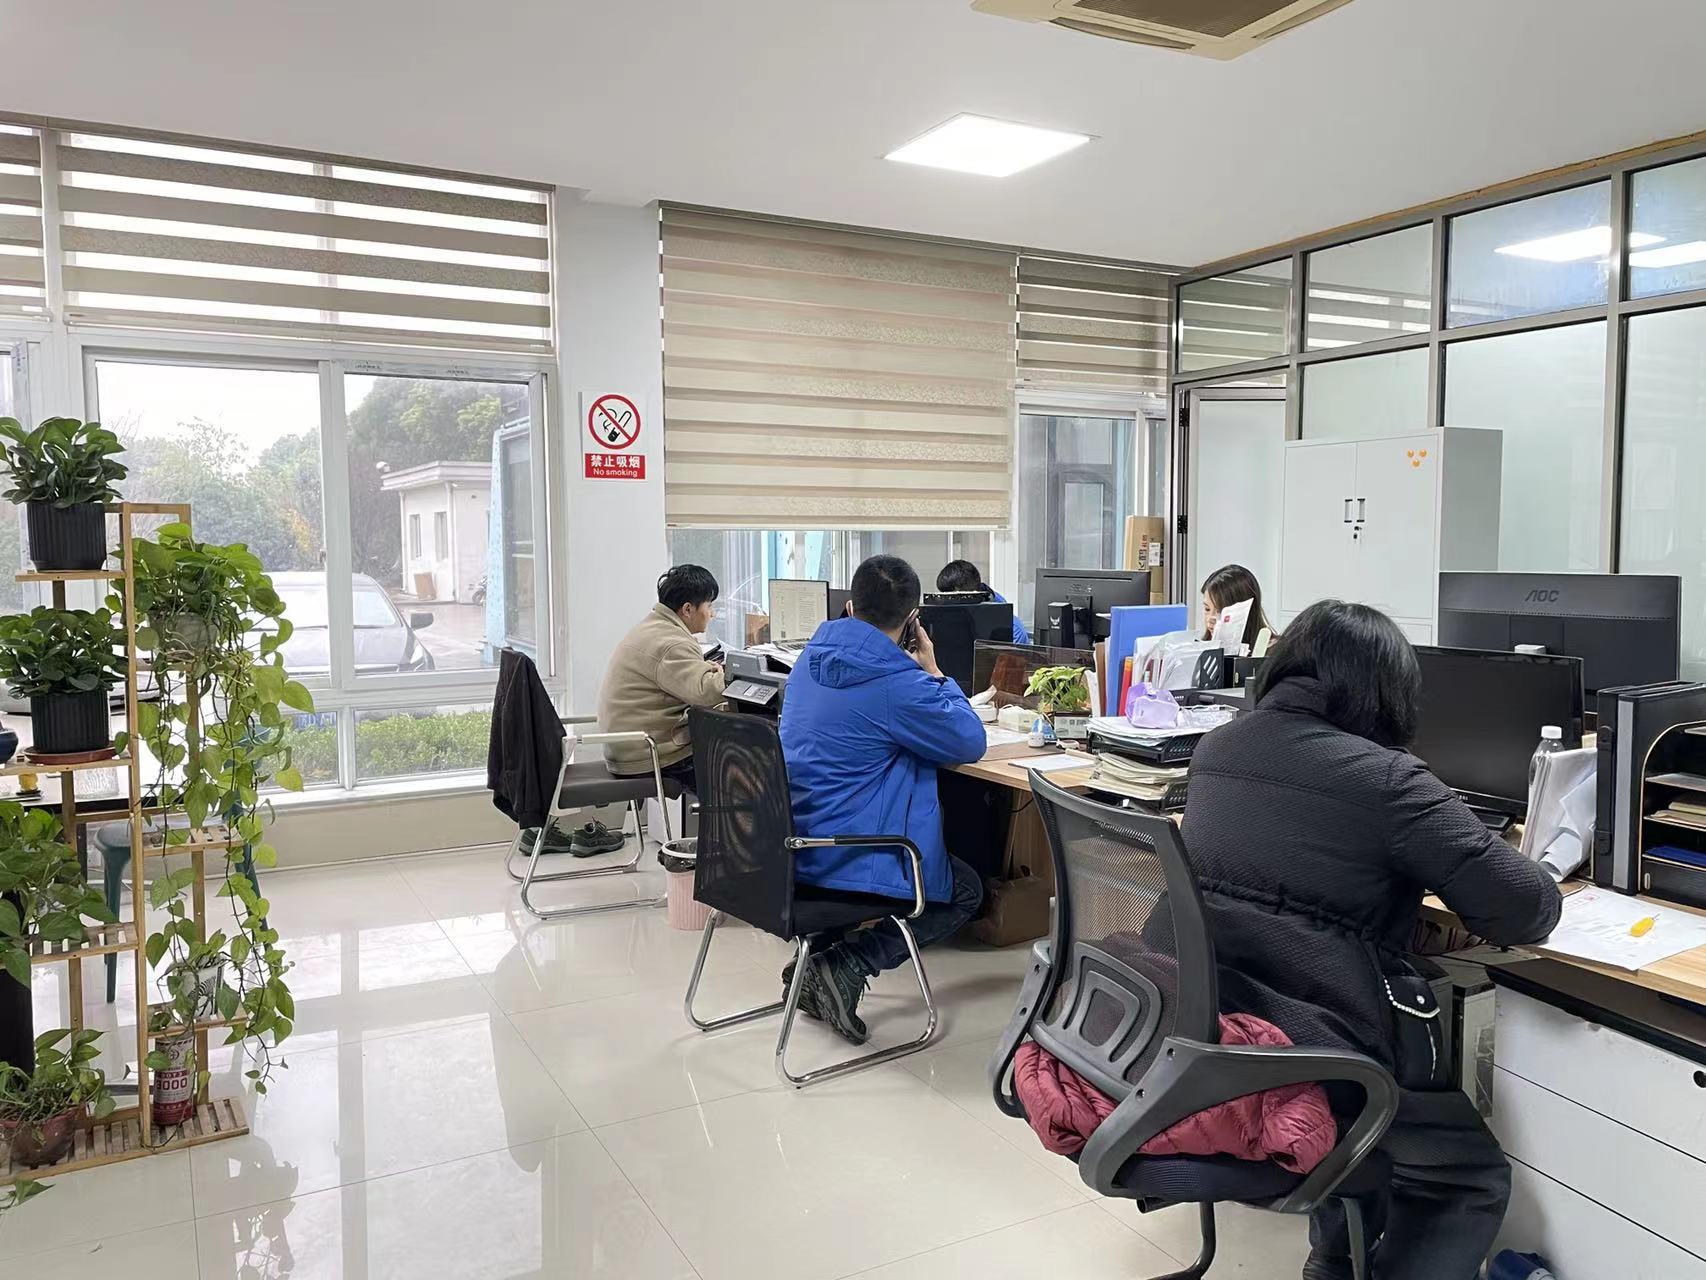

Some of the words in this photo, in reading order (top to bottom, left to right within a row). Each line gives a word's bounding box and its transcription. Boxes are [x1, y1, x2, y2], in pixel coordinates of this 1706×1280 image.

[590, 454, 640, 468] 禁止吸烟
[605, 469, 637, 477] smoking
[1525, 590, 1560, 602] AOC
